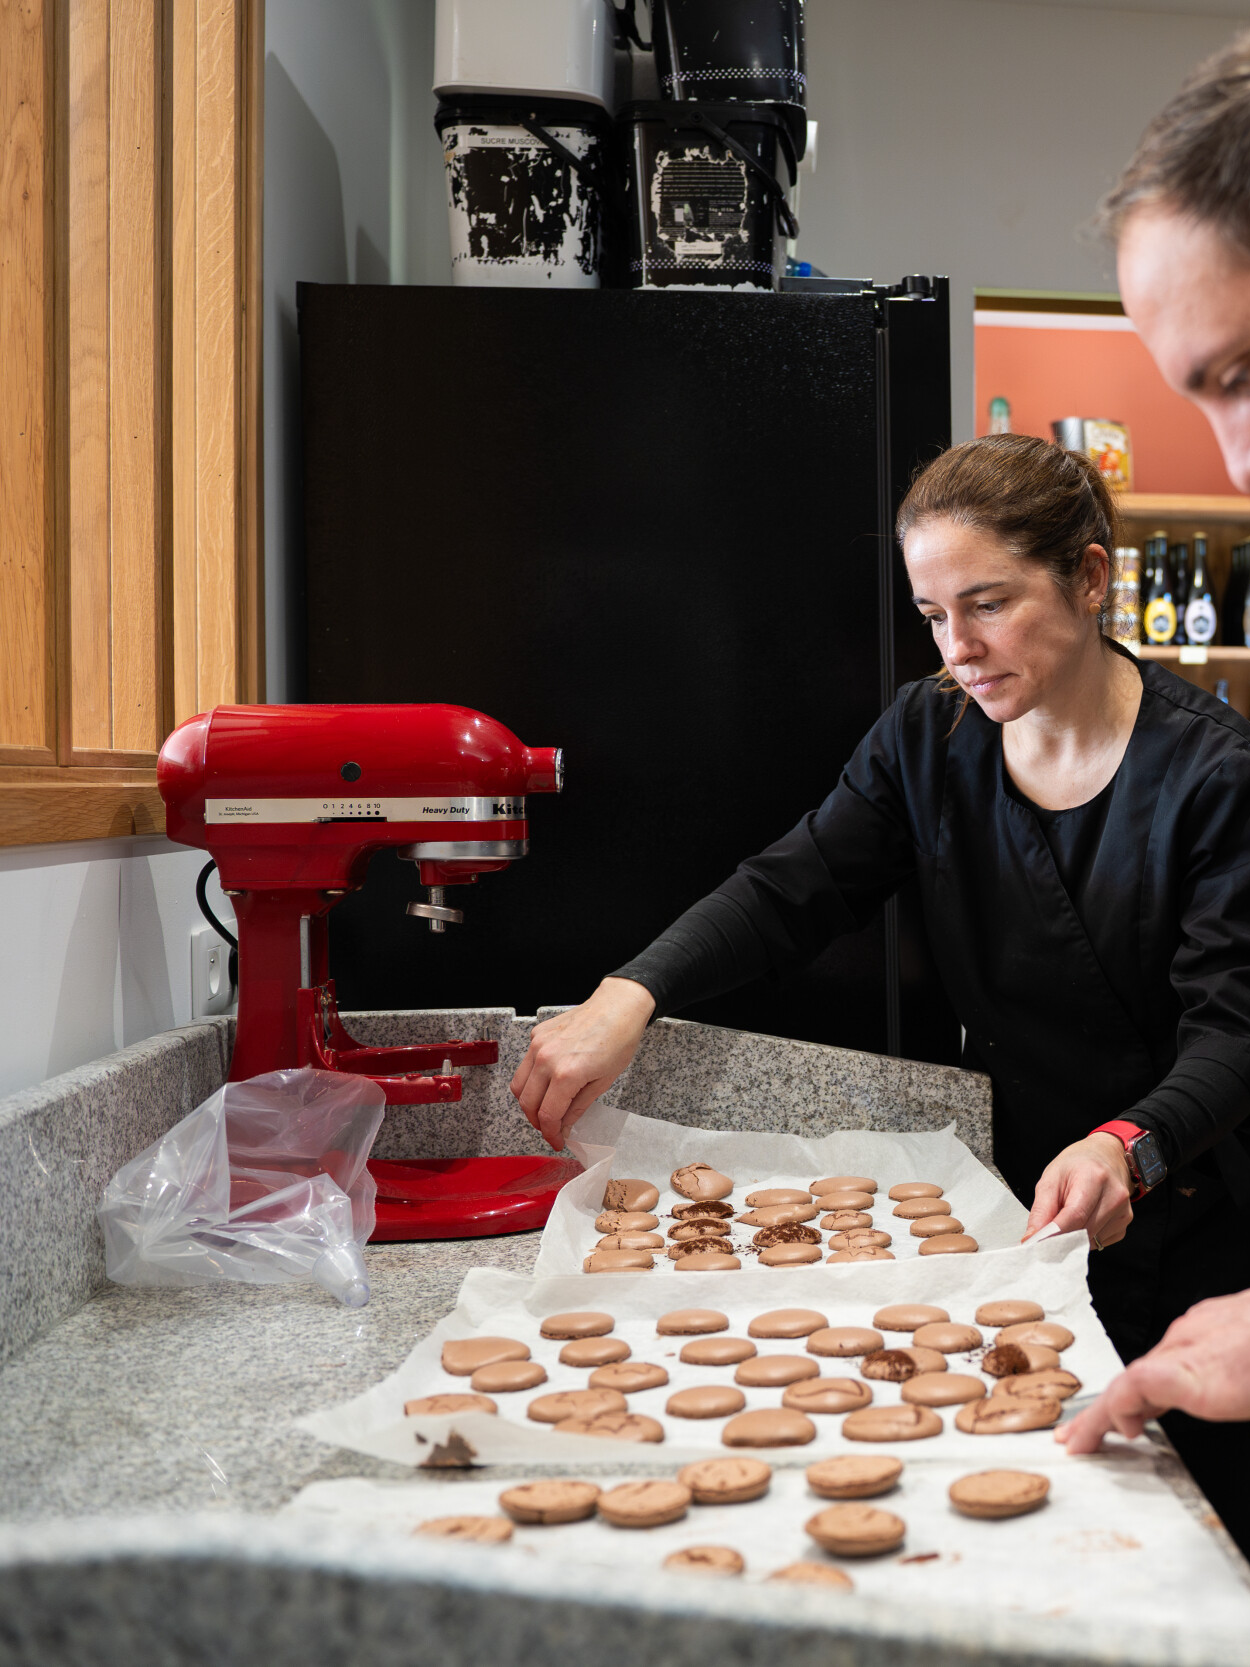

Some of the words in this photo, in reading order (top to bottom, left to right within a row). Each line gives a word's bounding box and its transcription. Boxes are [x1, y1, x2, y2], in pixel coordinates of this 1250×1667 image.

[480, 137, 507, 145] SUCRE
[422, 806, 448, 815] Heavy
[449, 806, 470, 815] Duty
